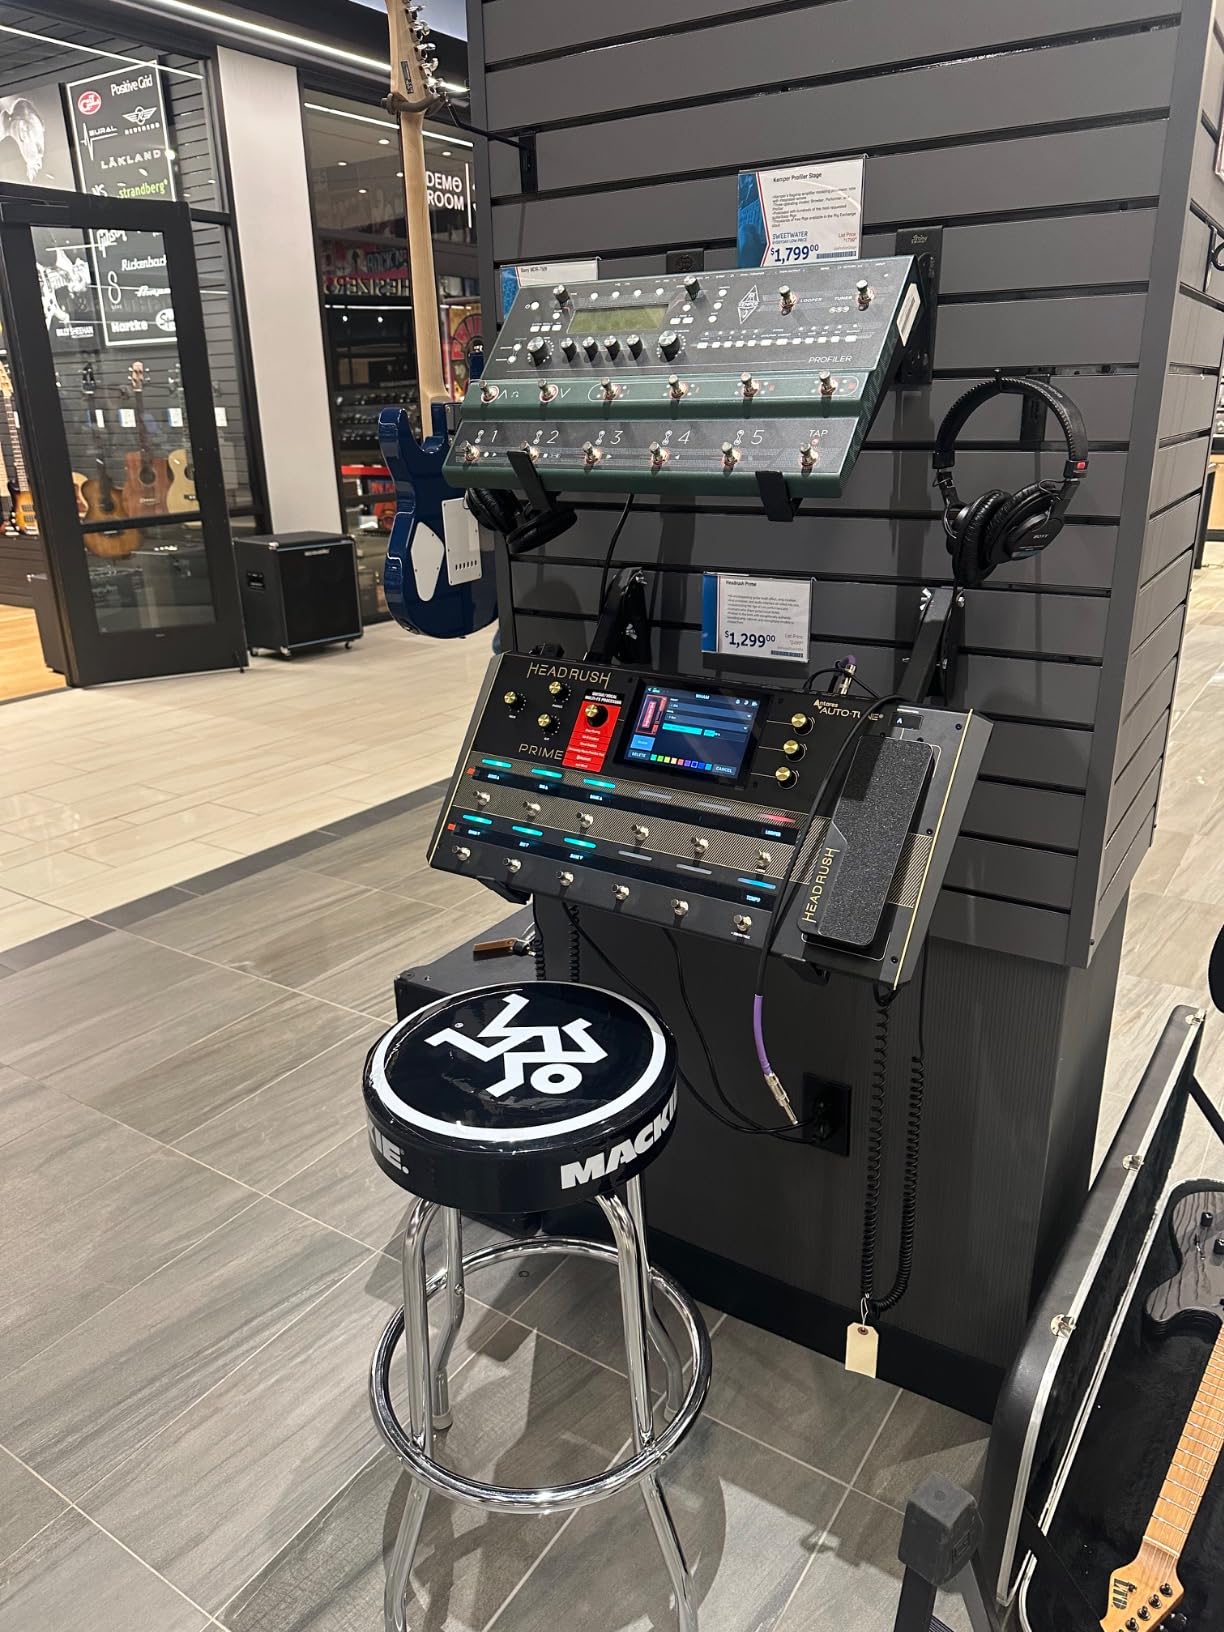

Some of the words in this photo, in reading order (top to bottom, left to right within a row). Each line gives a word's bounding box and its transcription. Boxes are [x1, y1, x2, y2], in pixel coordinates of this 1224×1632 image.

[111, 80, 138, 96] Positive
[138, 74, 153, 91] Grid
[426, 170, 462, 192] DEMO
[427, 189, 464, 211] ROOM
[773, 231, 808, 239] SWEETWATER
[111, 320, 148, 333] Hartke
[808, 355, 852, 363] PROFILER
[491, 430, 498, 443] 1
[546, 430, 560, 444] 2
[610, 430, 624, 444] 3
[678, 430, 691, 444] 4
[750, 430, 765, 444] 5
[808, 429, 829, 438] TAP
[527, 662, 612, 689] HEADRUSH
[813, 699, 838, 709] Antares
[518, 743, 564, 760] PRIME
[802, 847, 840, 924] HEADRUSH
[560, 1082, 678, 1190] MACKI
